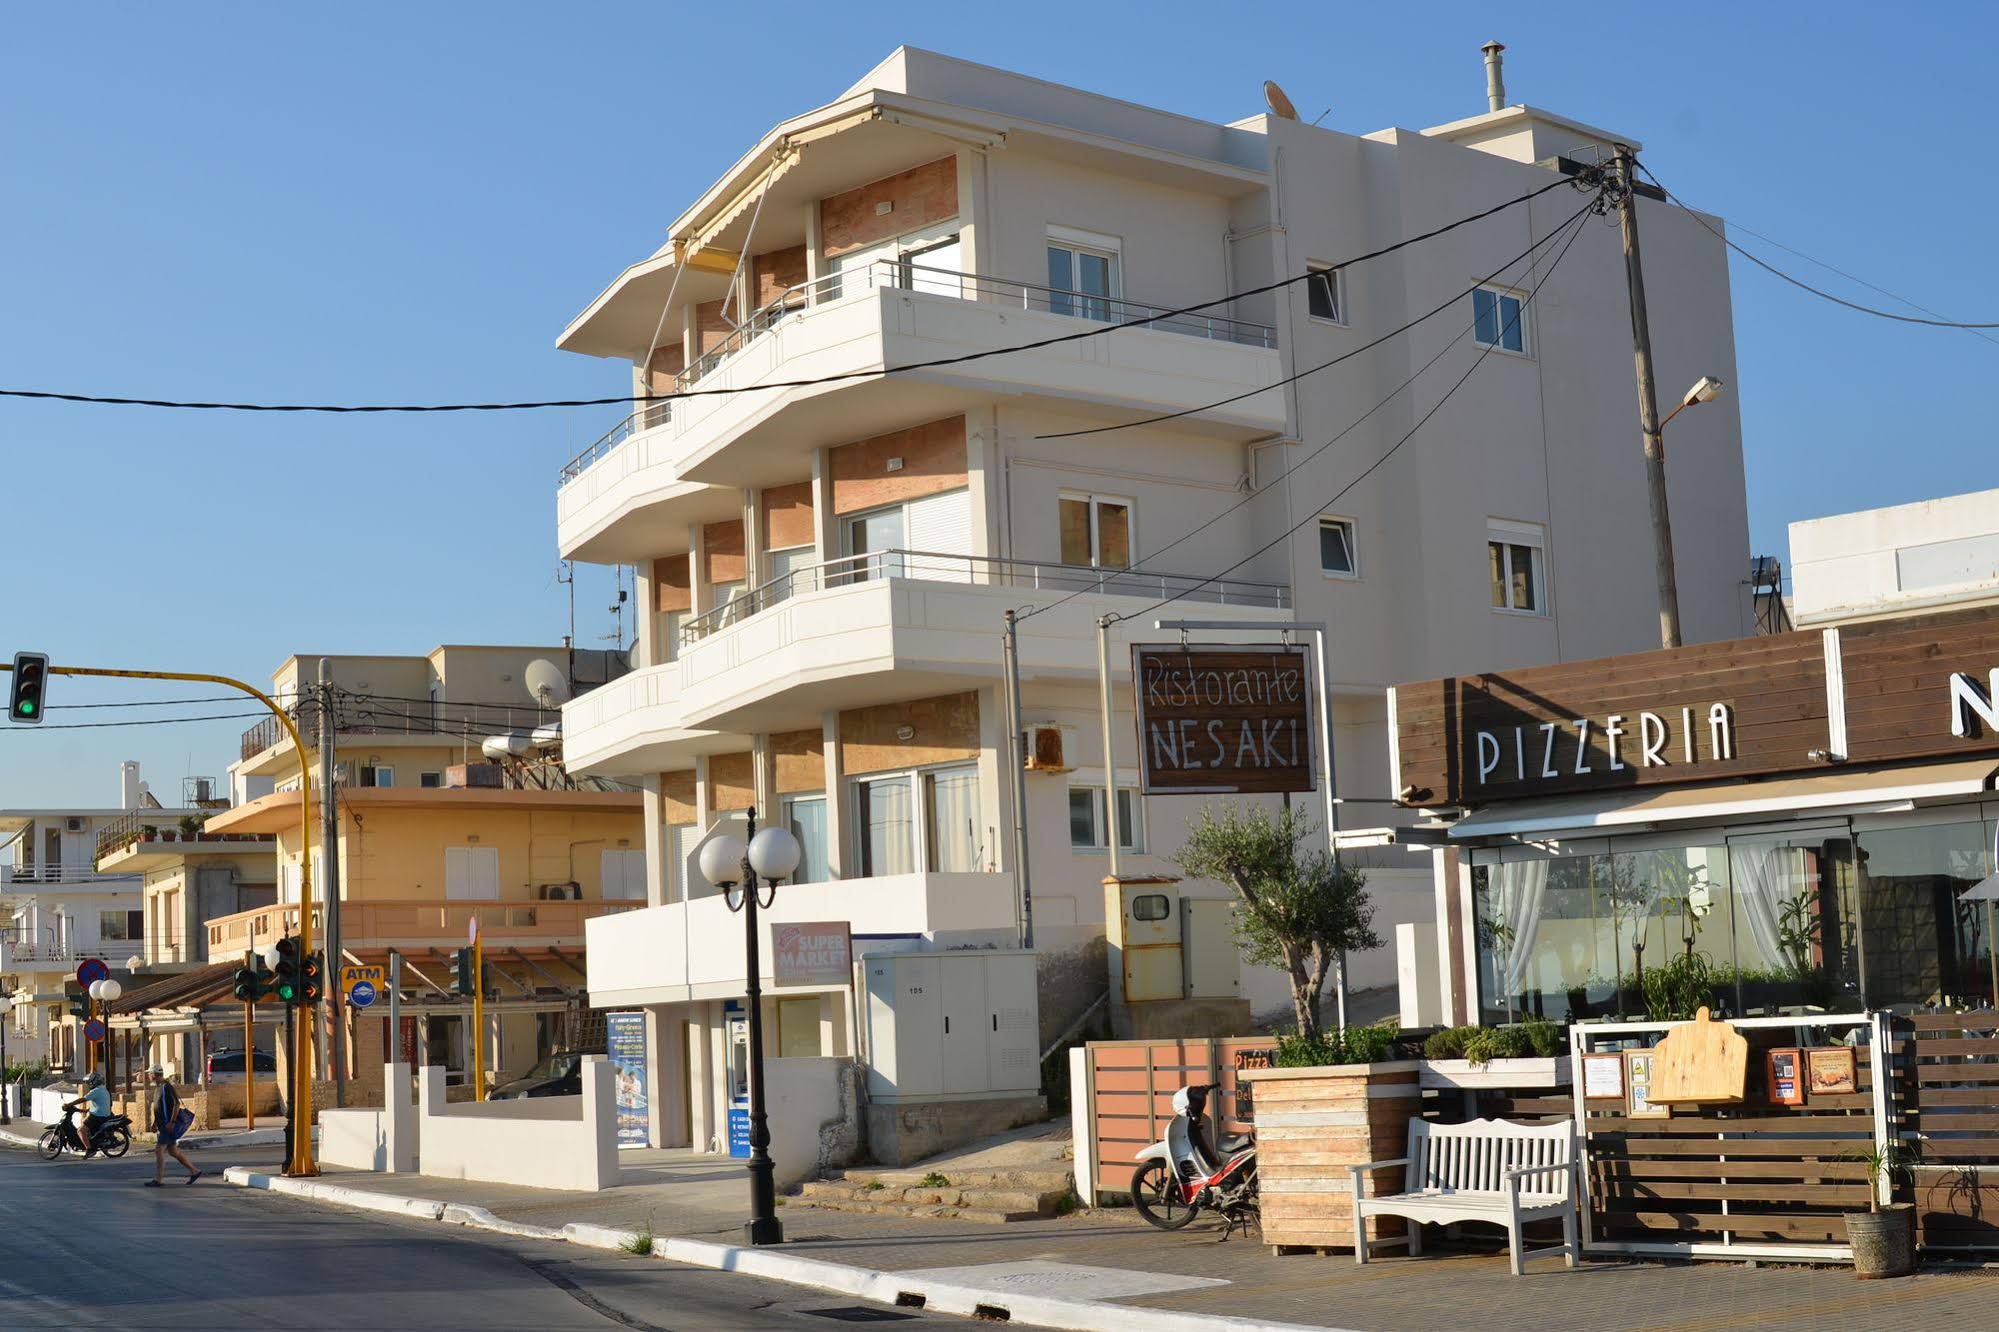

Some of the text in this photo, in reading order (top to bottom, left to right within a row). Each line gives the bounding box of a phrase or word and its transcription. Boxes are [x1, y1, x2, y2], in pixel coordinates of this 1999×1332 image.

[1146, 656, 1299, 706] Ristorante
[1151, 719, 1297, 769] NESAKI
[1477, 703, 1731, 784] PIZZERIA
[799, 935, 844, 951] SUPER
[779, 951, 846, 968] MARKET
[346, 968, 380, 980] ATM
[1235, 1054, 1269, 1070] Pizza
